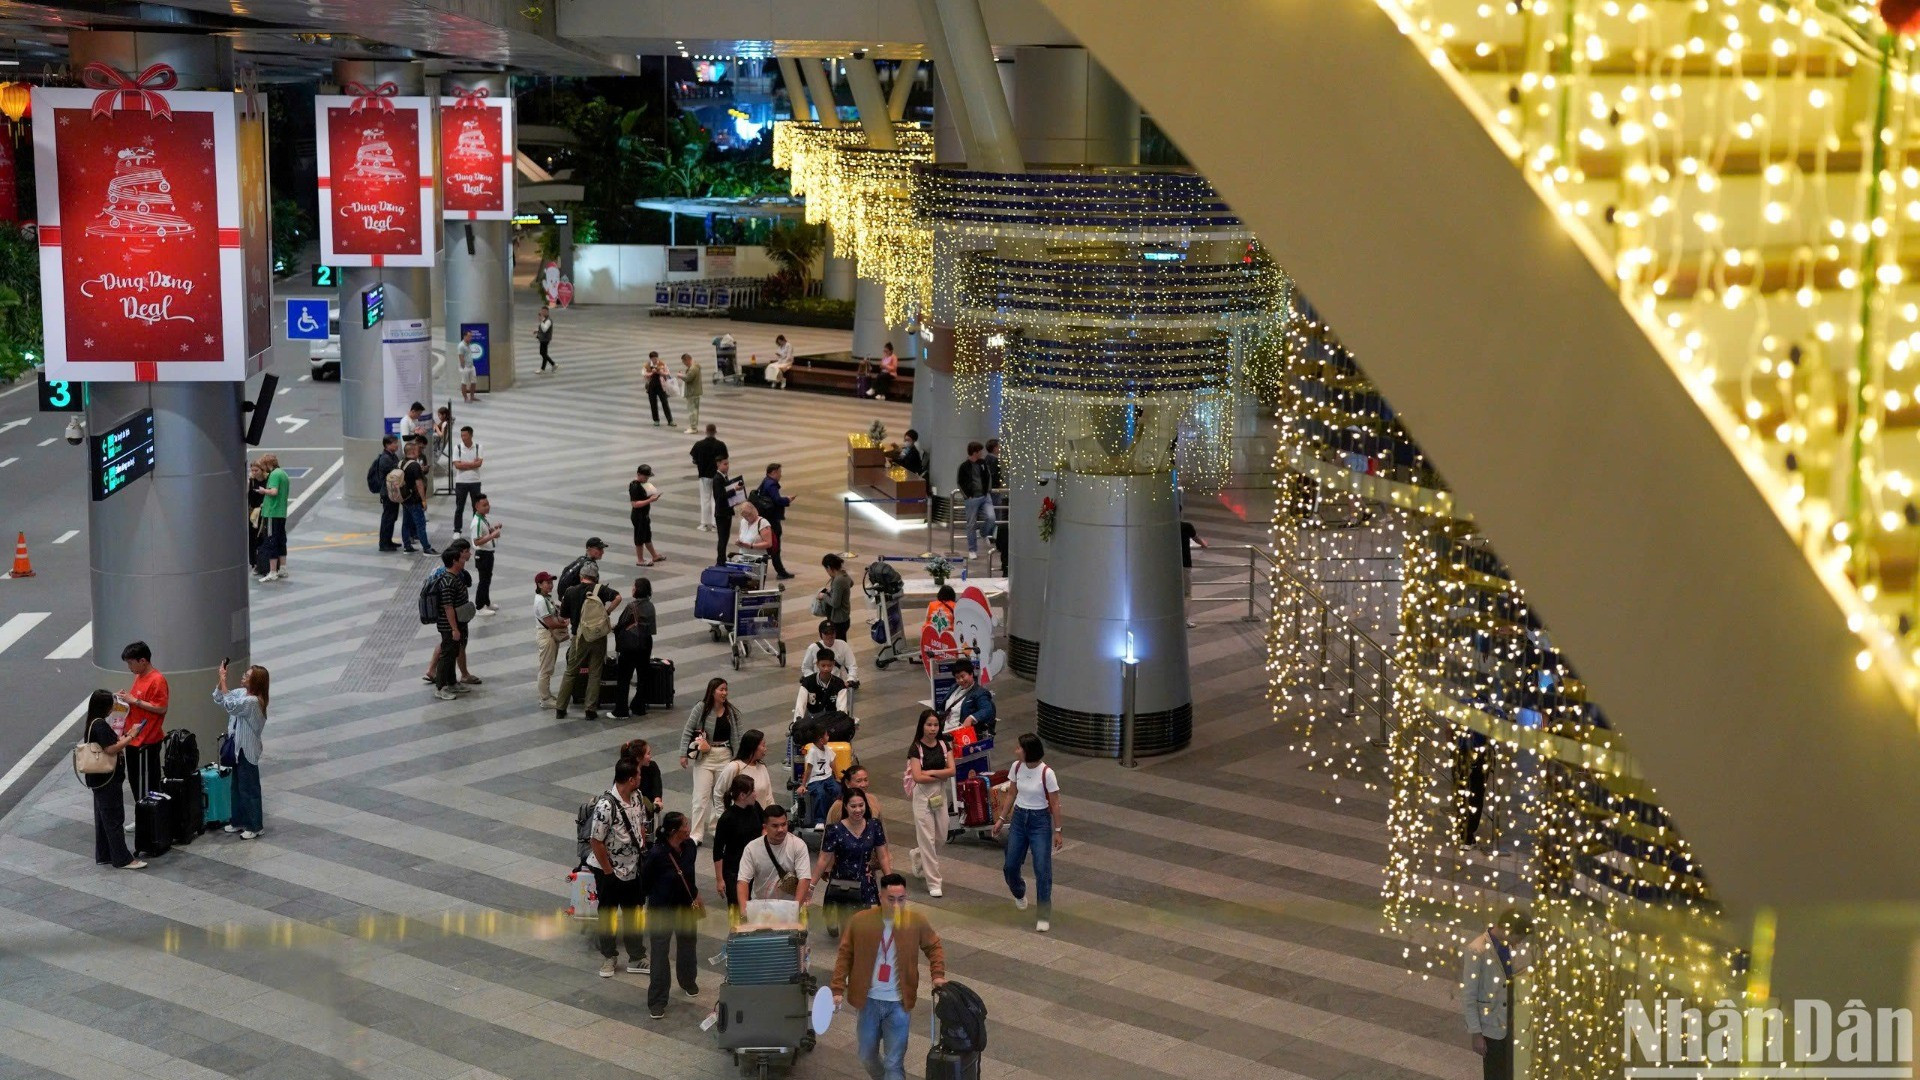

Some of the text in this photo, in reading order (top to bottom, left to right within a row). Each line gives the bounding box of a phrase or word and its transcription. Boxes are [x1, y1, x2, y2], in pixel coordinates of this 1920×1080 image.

[446, 172, 474, 184] Ding
[462, 183, 493, 196] Deal
[340, 201, 380, 217] Ding
[362, 215, 406, 234] Deal
[81, 272, 149, 298] Ding
[317, 266, 331, 285] 2
[119, 295, 195, 325] Deal
[49, 379, 71, 408] 3
